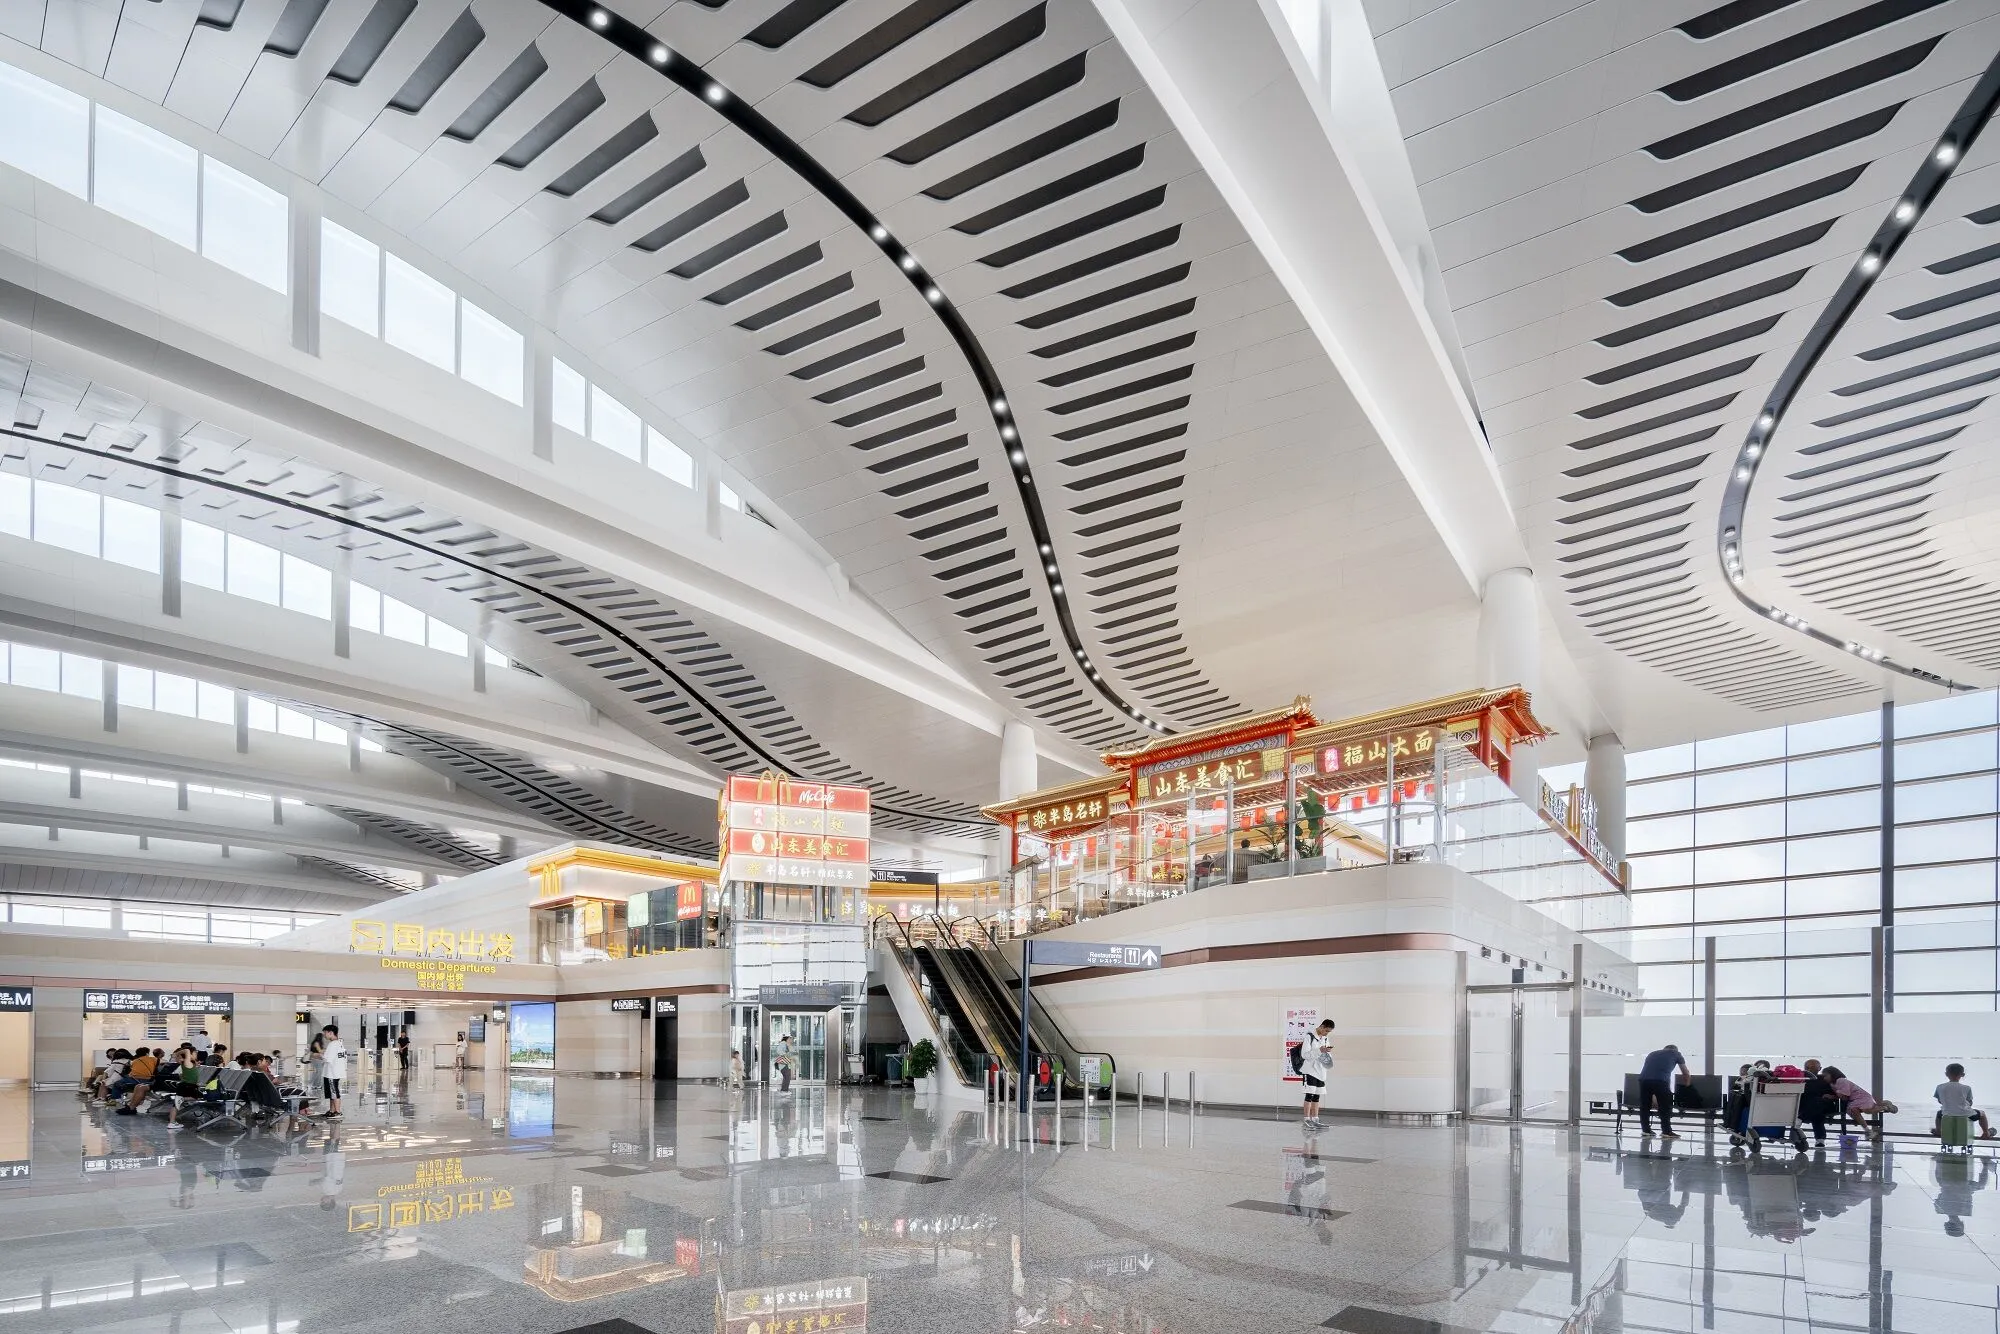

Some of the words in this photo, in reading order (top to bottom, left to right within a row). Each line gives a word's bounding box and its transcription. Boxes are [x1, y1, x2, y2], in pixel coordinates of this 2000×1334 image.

[1343, 729, 1432, 767] 福山大面
[1155, 758, 1254, 796] 山东美食汇
[393, 921, 516, 959] 国内出发
[1089, 951, 1122, 959] Restaurants
[382, 958, 435, 970] Domestic
[438, 961, 496, 974] Departures
